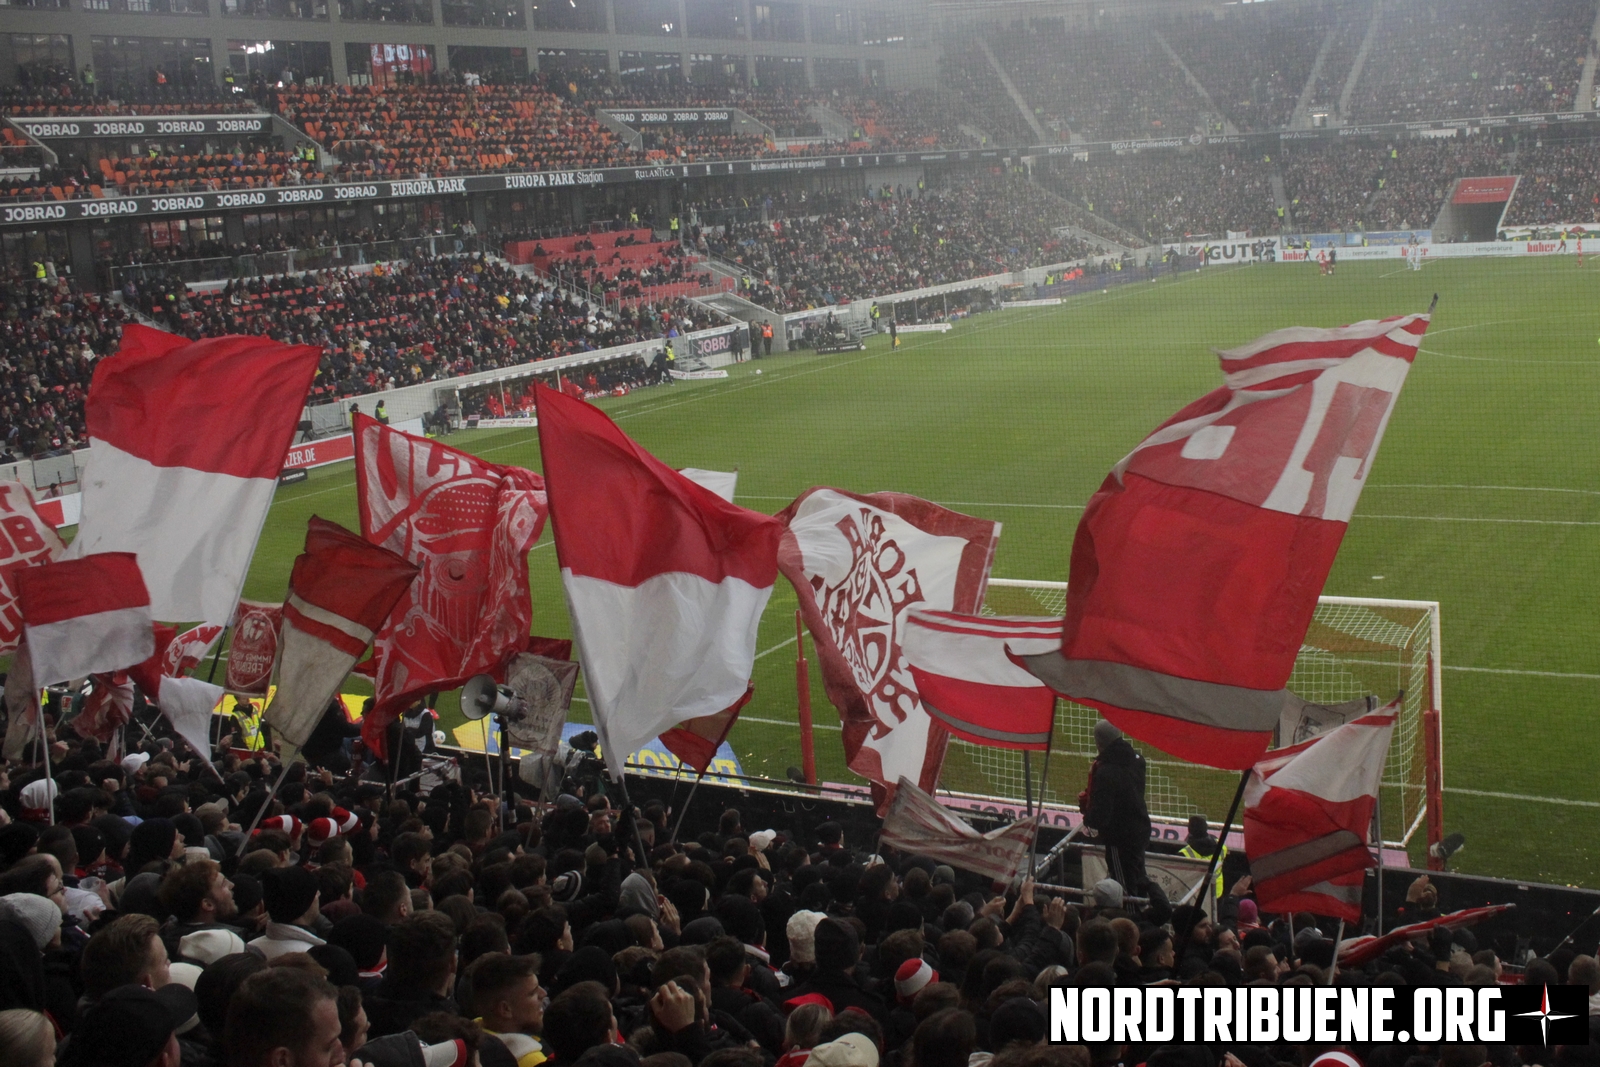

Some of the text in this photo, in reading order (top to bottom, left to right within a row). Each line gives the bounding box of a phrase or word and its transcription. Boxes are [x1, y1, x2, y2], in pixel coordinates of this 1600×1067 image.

[641, 113, 667, 122] JOBRAD
[673, 112, 698, 121] JOBRAD
[704, 112, 728, 120] JOBRAD
[26, 124, 79, 136] JOBRAD
[94, 122, 144, 135] JOBRAD
[157, 121, 204, 133] JOBRAD
[217, 120, 261, 131] JOBRAD
[1111, 139, 1183, 150] BGV-Familienblock
[505, 171, 603, 188] EUROPA PARK Stadion
[335, 186, 377, 198] JOBRAD
[390, 179, 466, 196] EUROPA PARK
[217, 193, 265, 207] JOBRAD
[278, 189, 323, 202] JOBRAD
[81, 201, 137, 216] JOBRAD
[152, 197, 204, 211] JOBRAD
[5, 206, 65, 221] JOBRAD
[1352, 249, 1388, 257] temperature
[1476, 245, 1513, 253] temperature
